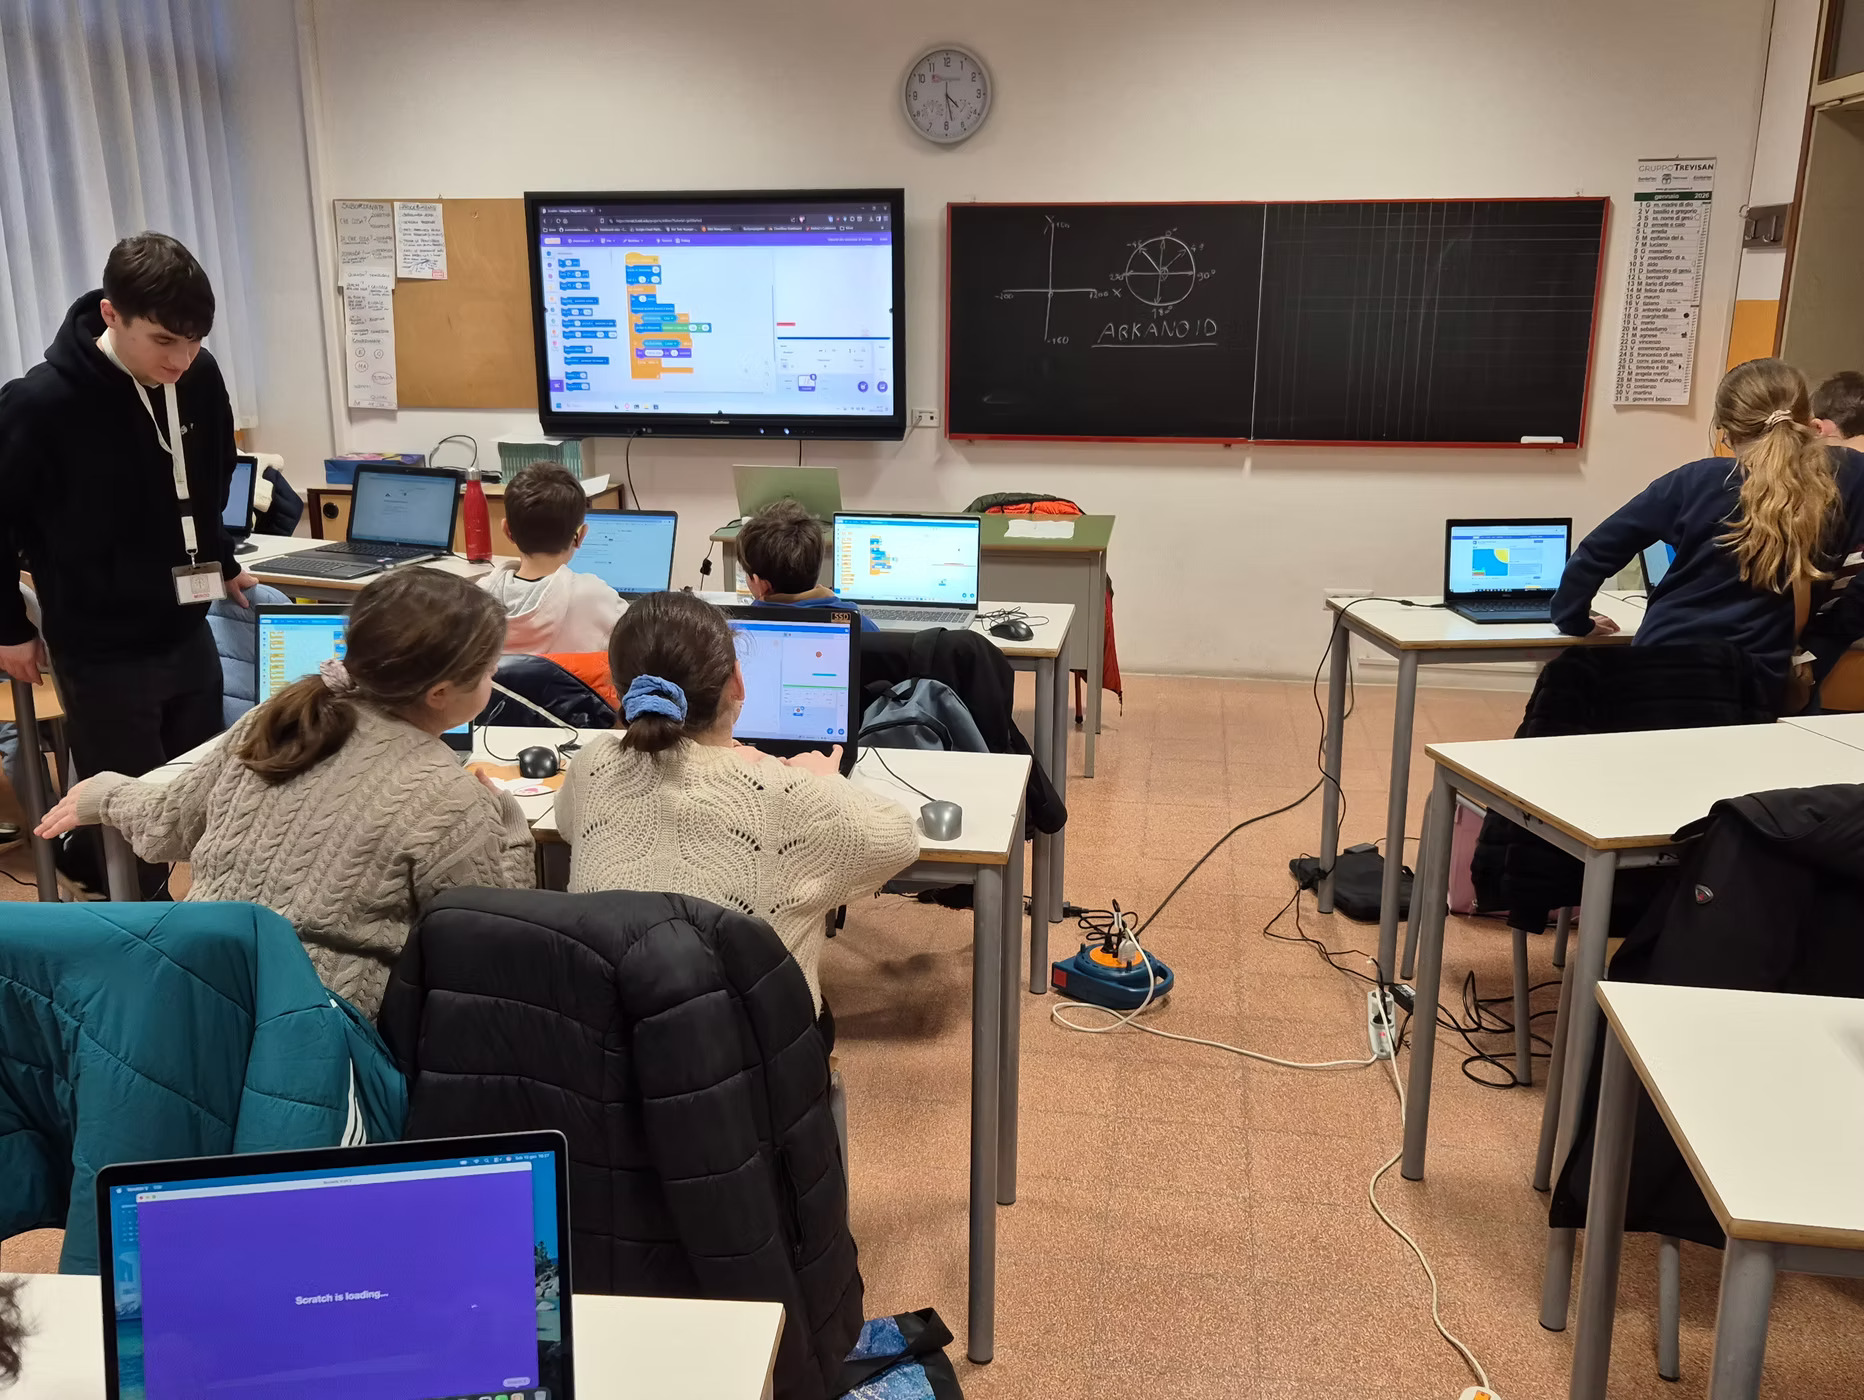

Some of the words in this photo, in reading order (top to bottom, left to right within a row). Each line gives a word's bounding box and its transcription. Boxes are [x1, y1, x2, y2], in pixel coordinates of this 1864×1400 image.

[929, 63, 934, 72] 11
[944, 58, 950, 68] 12
[960, 61, 964, 70] 1
[918, 74, 925, 84] 10
[971, 72, 976, 82] 2
[913, 91, 917, 100] 9
[976, 89, 981, 98] 3
[944, 121, 949, 130] 6
[1098, 318, 1217, 343] ARKANOID
[296, 1294, 332, 1305] Scratch
[335, 1293, 343, 1301] is
